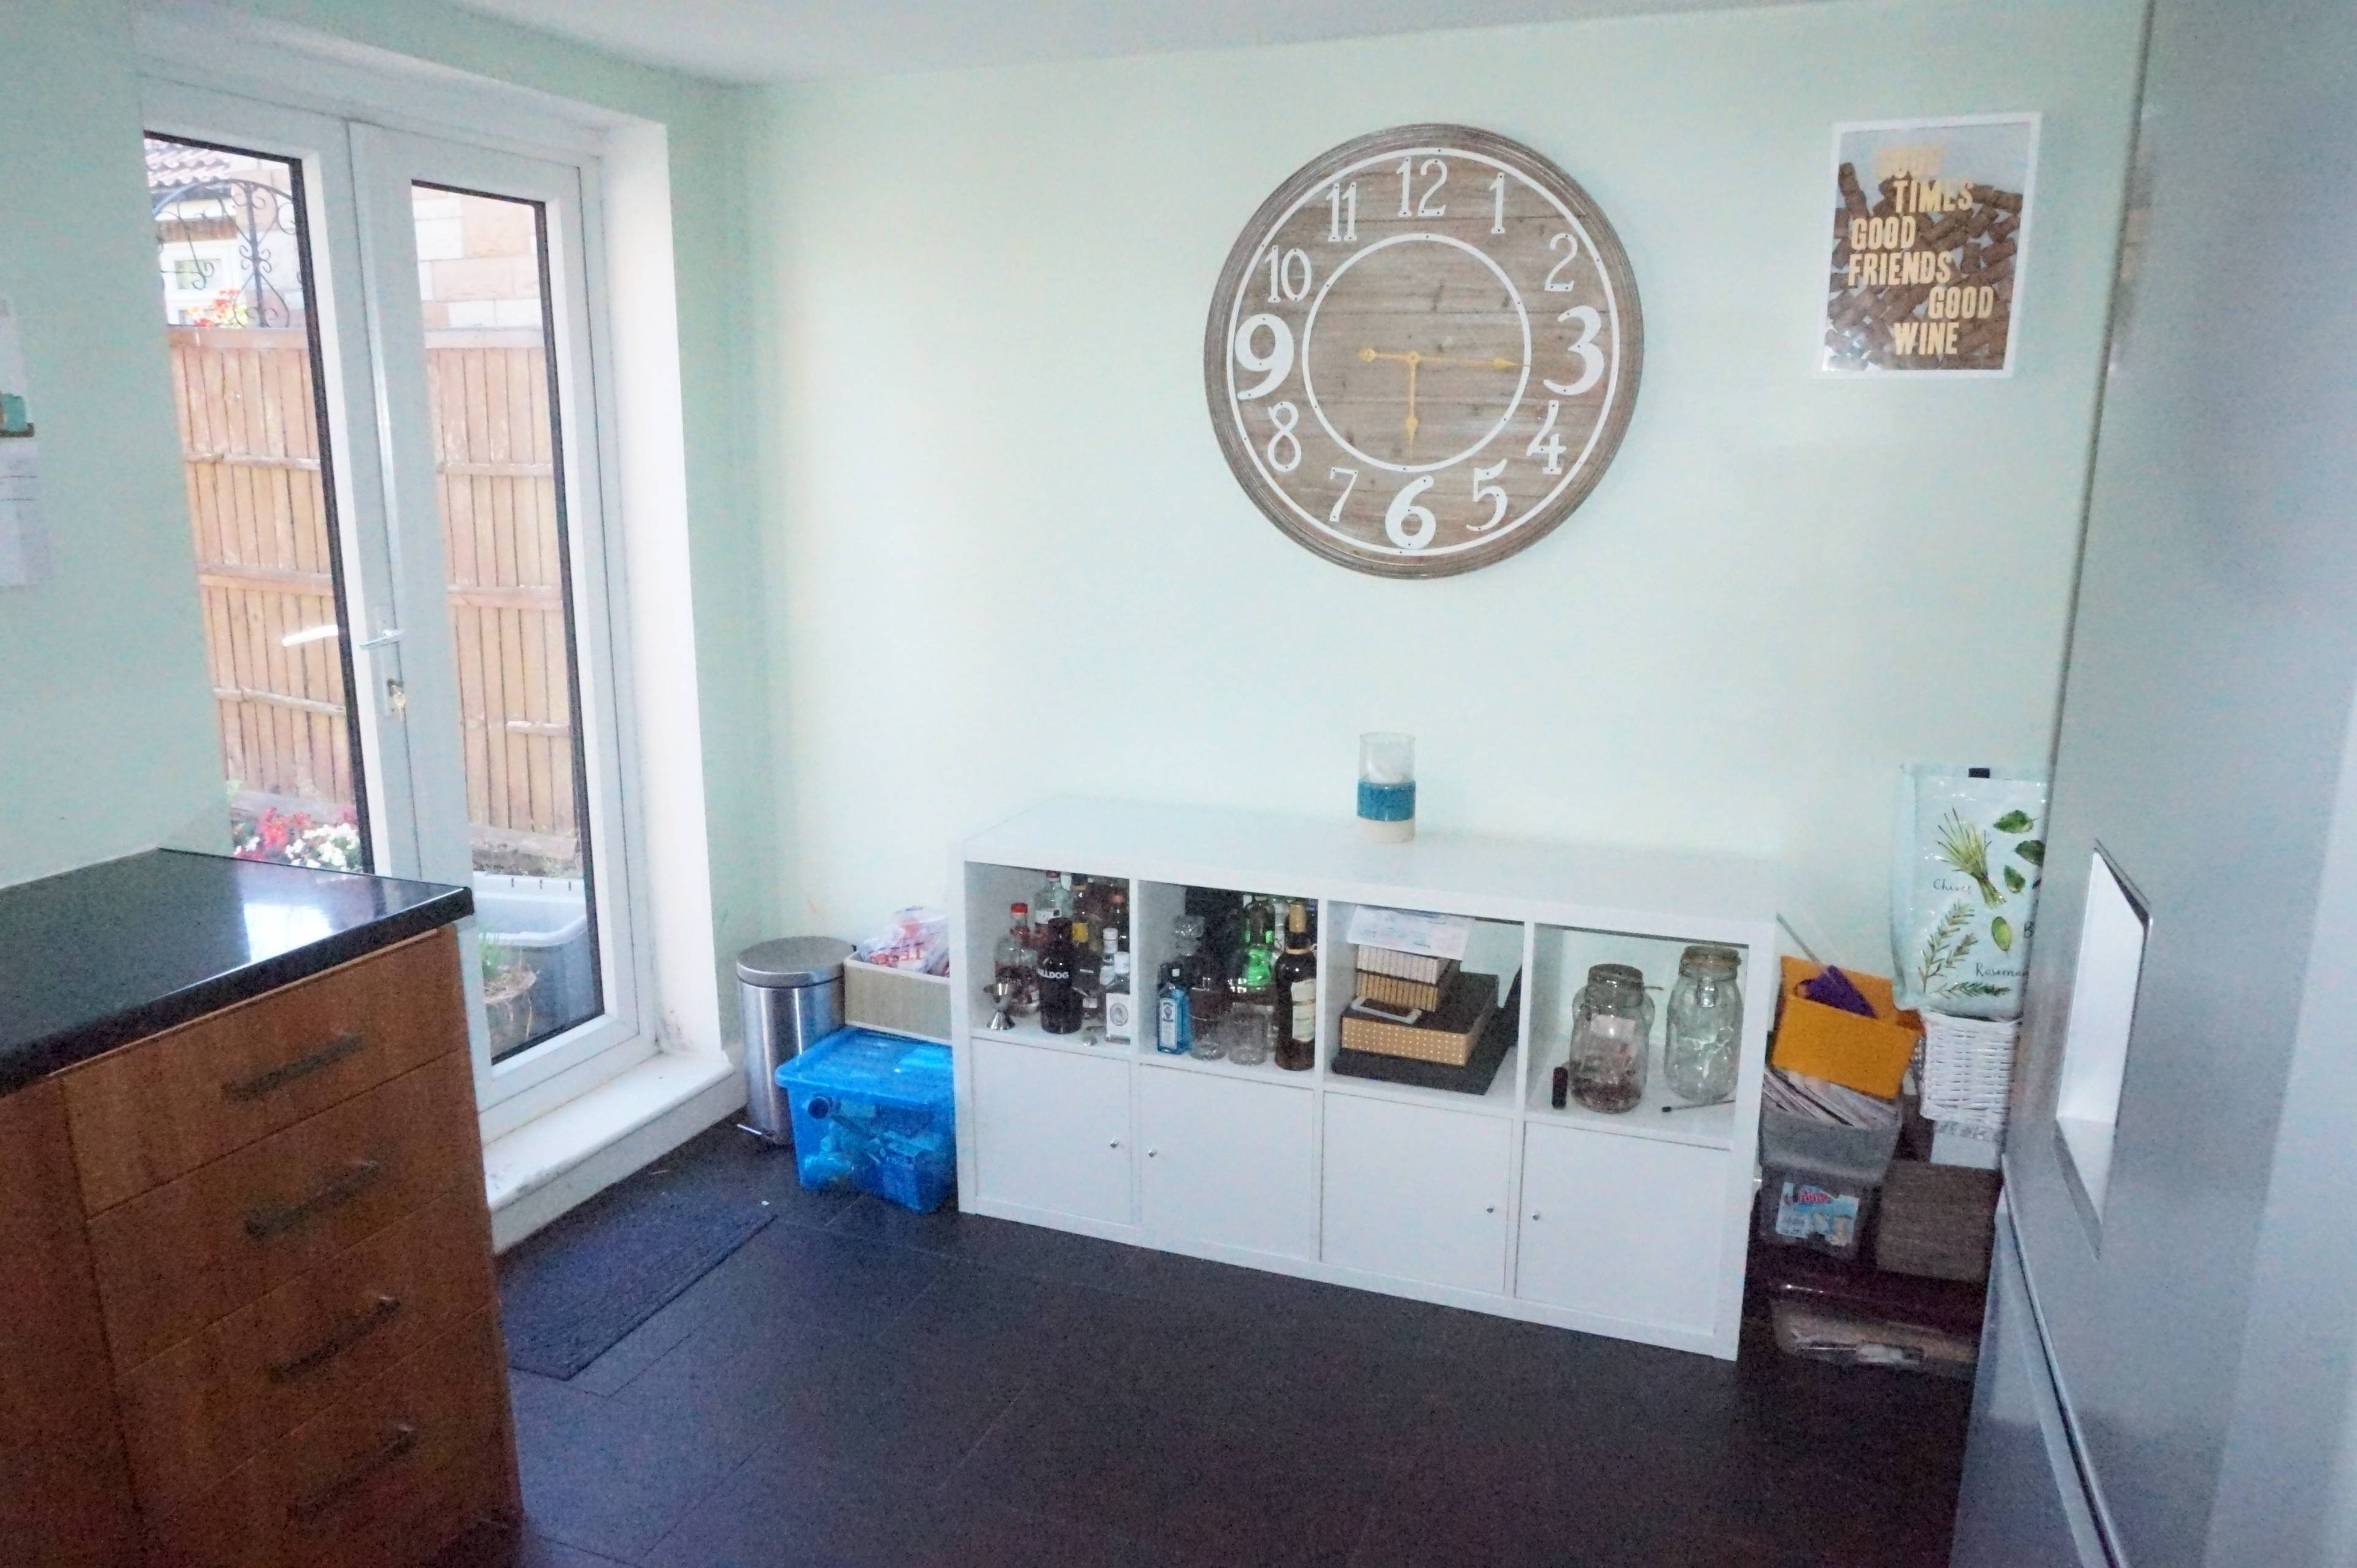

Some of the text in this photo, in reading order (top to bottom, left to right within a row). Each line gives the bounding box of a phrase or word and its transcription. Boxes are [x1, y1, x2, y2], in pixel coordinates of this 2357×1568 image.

[1325, 181, 1357, 242] 11
[1396, 155, 1449, 218] 12
[1488, 171, 1505, 234] 1
[1892, 177, 1974, 213] TIMES
[1544, 233, 1579, 292] 2
[1851, 216, 1916, 250] GOOD
[1263, 244, 1312, 304] 10
[1848, 250, 1953, 286] FRIENDS
[1928, 285, 1994, 319] GOOD
[1234, 314, 1294, 401] 9
[1543, 305, 1605, 396] 3
[1894, 322, 1959, 355] WINE
[1268, 401, 1302, 473] 8
[1526, 400, 1566, 474] 4
[1329, 466, 1358, 522] 7
[1385, 475, 1436, 550] 6
[1465, 458, 1508, 531] 5
[1037, 967, 1069, 979] LLDOG
[1975, 962, 2029, 977] Rosema
